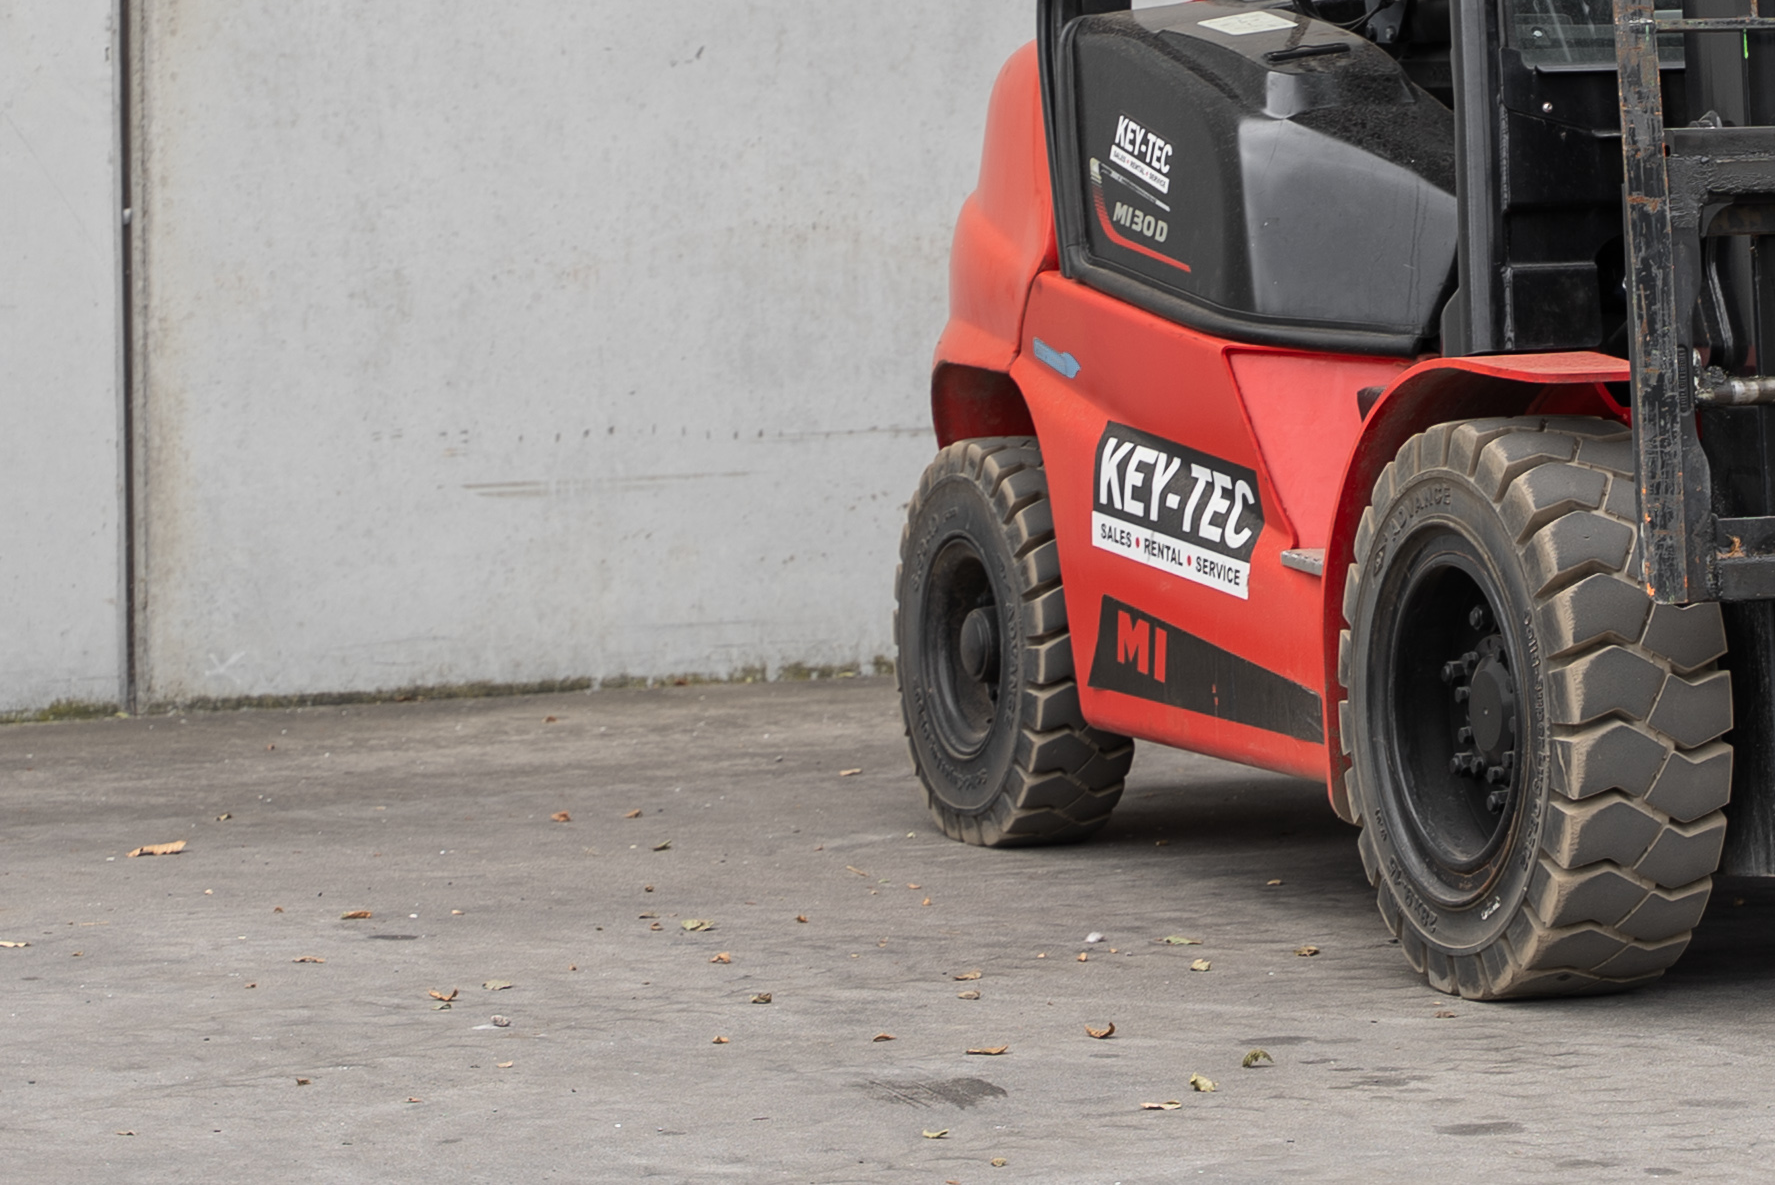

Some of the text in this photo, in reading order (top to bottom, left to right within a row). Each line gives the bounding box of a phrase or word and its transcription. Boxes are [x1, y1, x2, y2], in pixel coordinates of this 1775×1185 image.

[1114, 114, 1173, 174] KEY-TEC
[1112, 201, 1169, 243] MI30D
[1099, 436, 1256, 550] KEY-TEC
[1382, 482, 1452, 543] ADVANCE
[1100, 522, 1241, 587] SALES RENTAL SERVICE
[1117, 609, 1168, 684] MI
